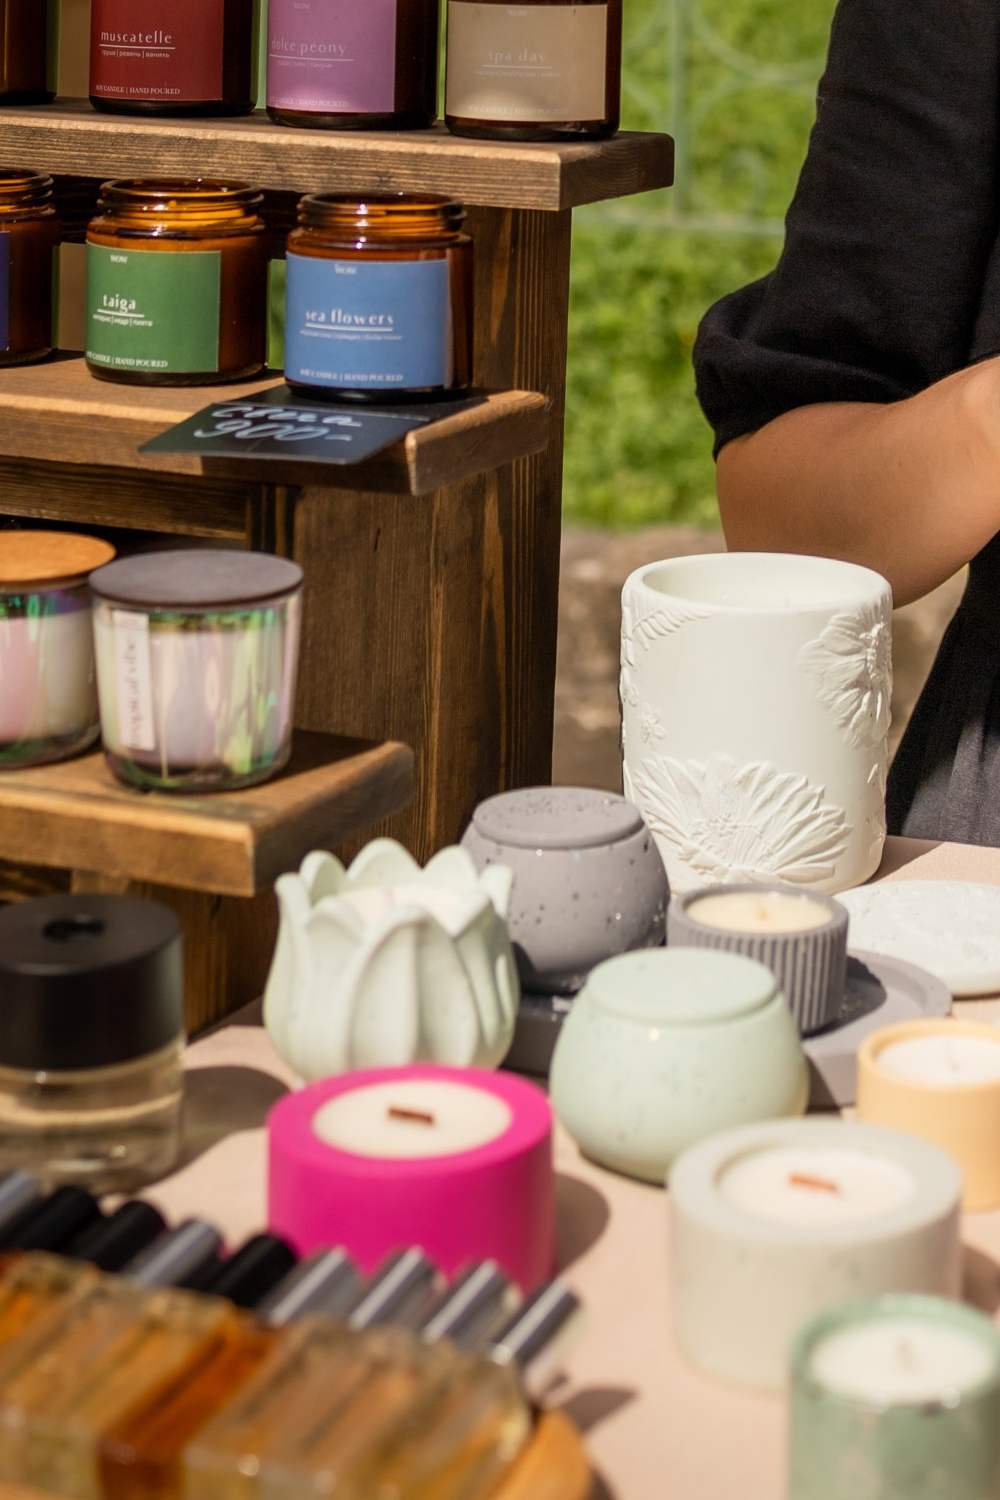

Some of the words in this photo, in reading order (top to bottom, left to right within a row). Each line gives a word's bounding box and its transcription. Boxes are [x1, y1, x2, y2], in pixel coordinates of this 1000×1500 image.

[101, 30, 172, 44] muscatelle
[271, 36, 296, 52] dolce
[300, 43, 346, 57] peony
[488, 51, 512, 64] spa
[518, 48, 546, 64] day
[104, 85, 125, 93] CANDLE
[150, 87, 180, 95] POURED
[103, 294, 136, 313] taiga
[305, 310, 326, 323] sea
[331, 308, 394, 326] flowers
[115, 357, 135, 366] HAND
[136, 358, 168, 368] POURED
